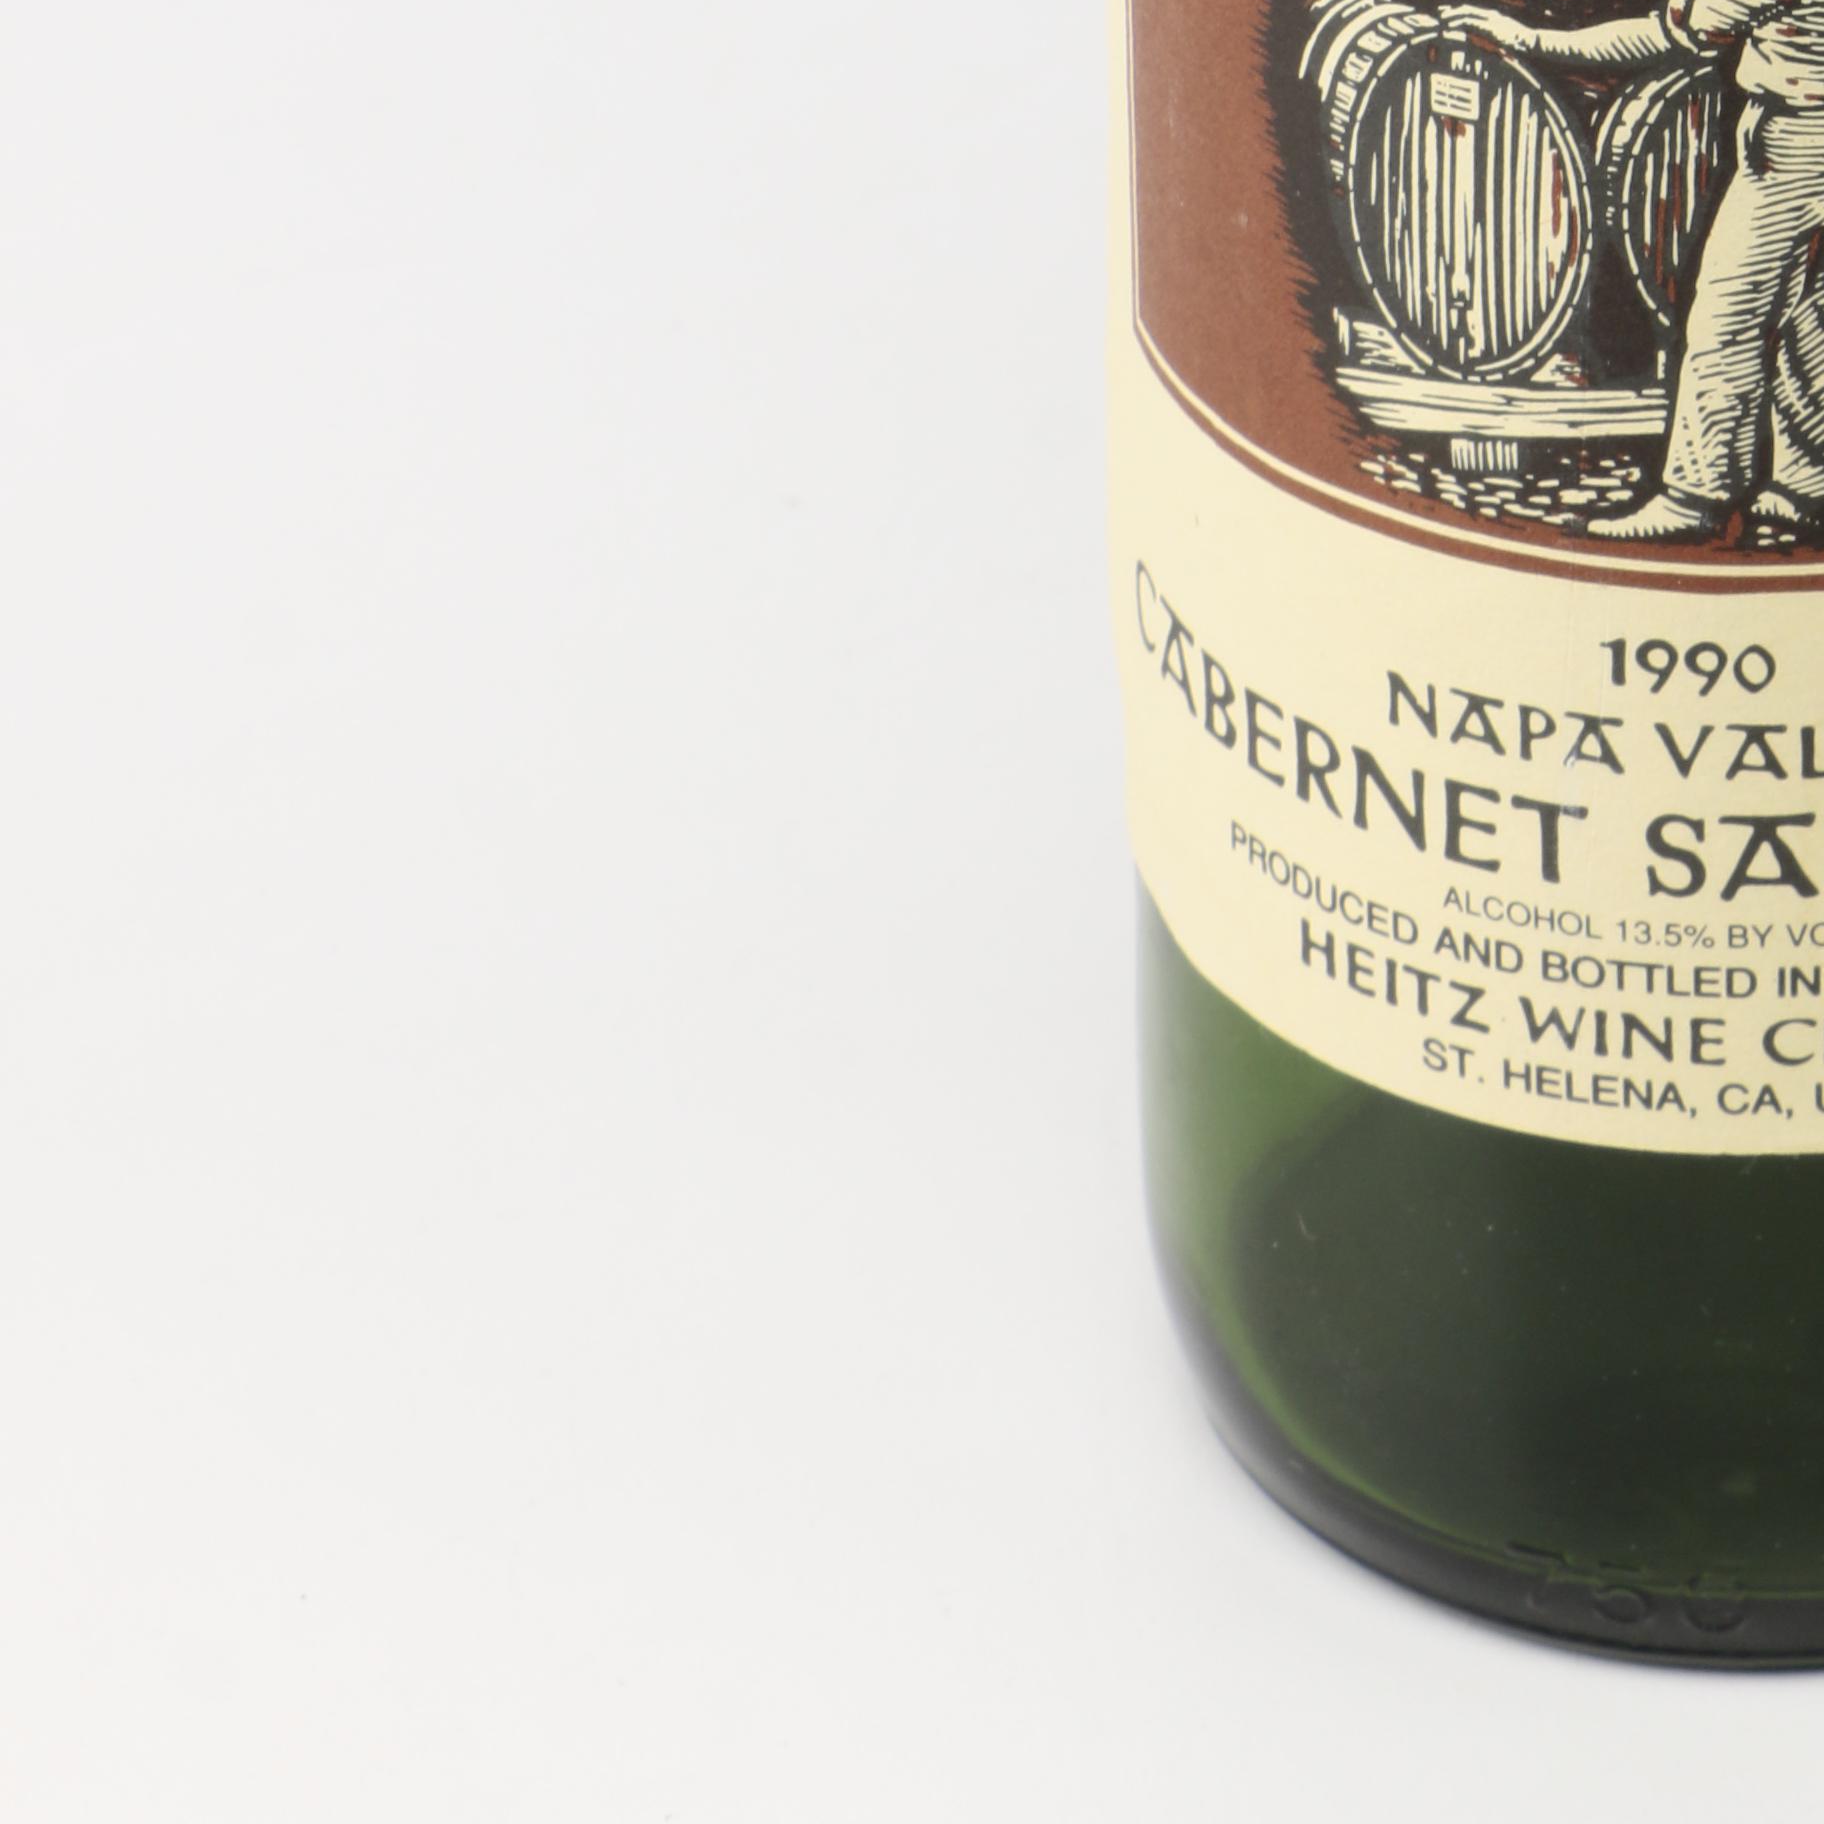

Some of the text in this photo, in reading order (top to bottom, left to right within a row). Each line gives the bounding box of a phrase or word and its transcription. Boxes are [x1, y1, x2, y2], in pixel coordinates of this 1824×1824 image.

[1600, 638, 1776, 696] 1990
[1134, 558, 1589, 884] CABERNET
[1386, 669, 1626, 775] NAPA
[1230, 819, 1419, 945] PRODUCED
[1433, 926, 1524, 974] AND
[1541, 956, 1758, 999] BOTTLED
[1777, 965, 1822, 1000] IN
[1443, 885, 1603, 940] ALCOHOL
[1616, 918, 1716, 949] 13.5%
[1727, 918, 1775, 948] BY
[1299, 916, 1491, 1035] HEITZ
[1518, 995, 1727, 1066] WINE
[1422, 1037, 1486, 1083] ST.
[1502, 1058, 1698, 1118] HELENA,
[1717, 1082, 1795, 1120] CA,
